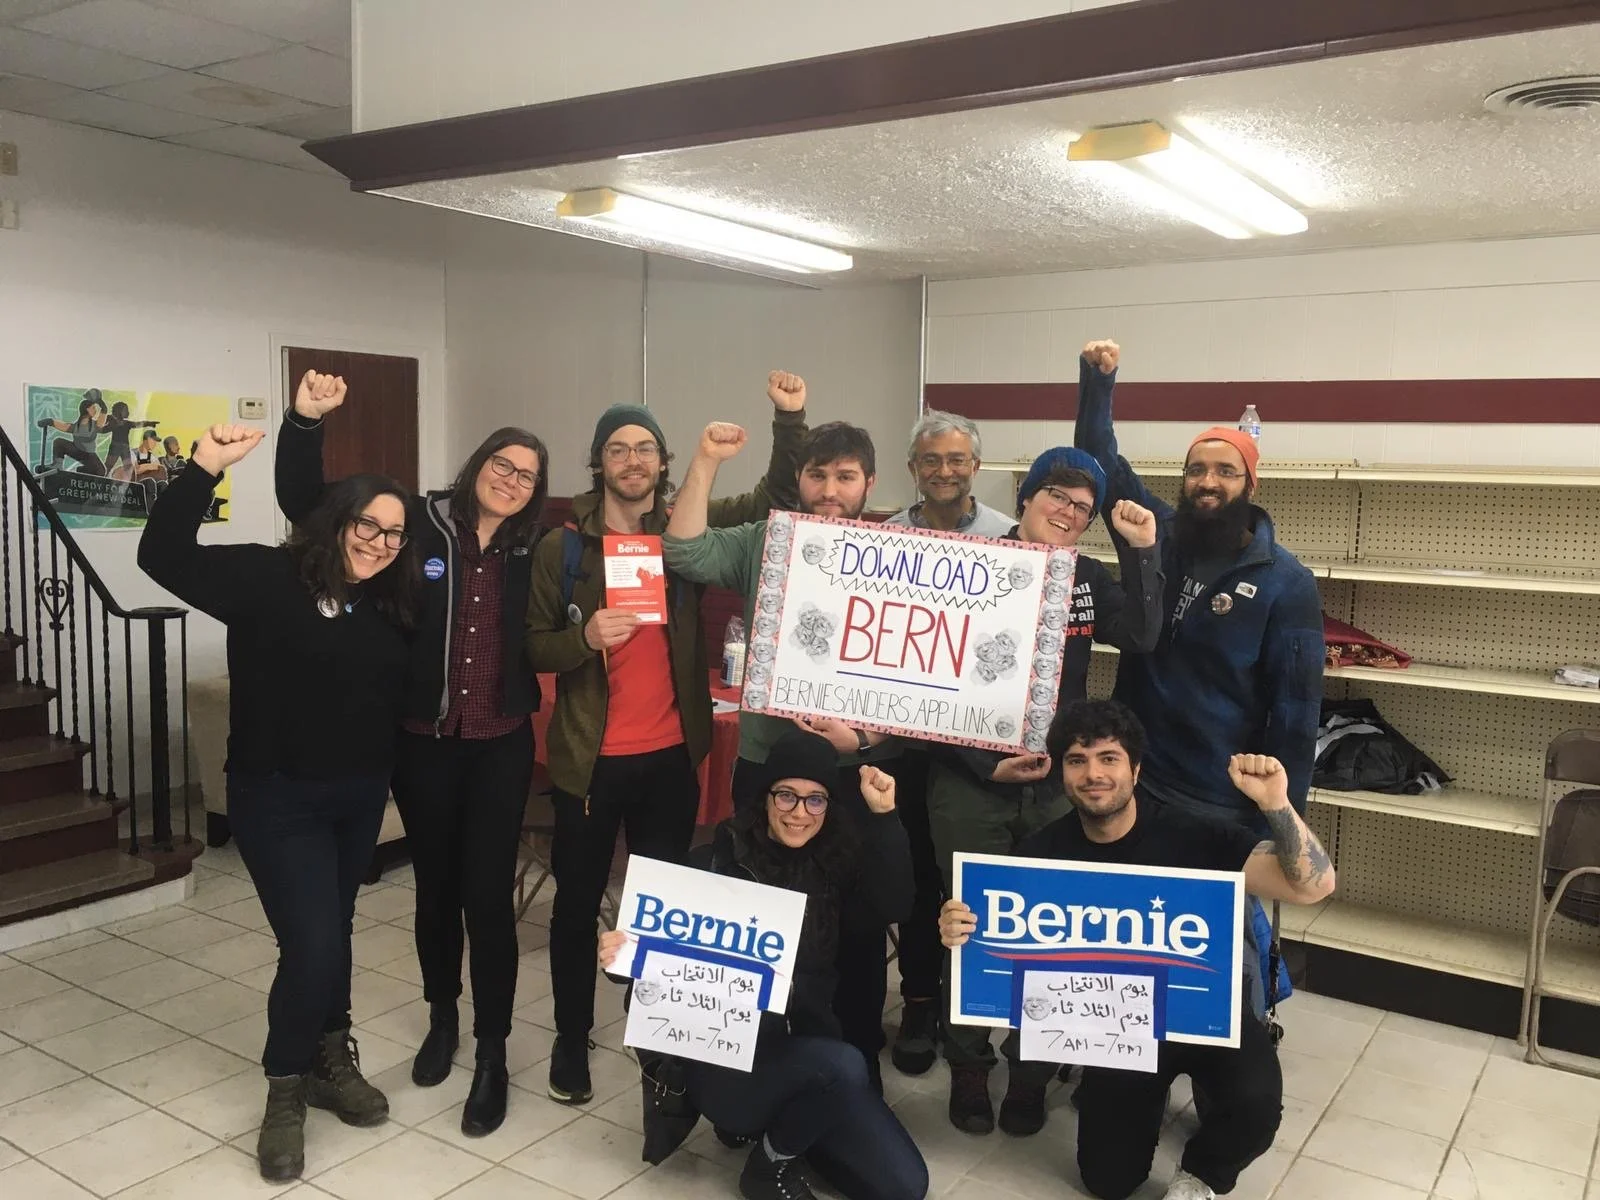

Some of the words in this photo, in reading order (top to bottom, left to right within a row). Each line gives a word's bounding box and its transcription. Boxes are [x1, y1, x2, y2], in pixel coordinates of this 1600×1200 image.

[59, 487, 92, 500] GREEN
[96, 493, 118, 503] NEW
[120, 496, 142, 506] DEAL
[70, 479, 102, 491] READY
[105, 484, 126, 494] FOR
[127, 487, 133, 496] A
[617, 543, 650, 553] Bernie
[840, 543, 989, 596] DOWNLOAD
[1072, 582, 1092, 595] all
[1075, 595, 1094, 607] all
[1078, 609, 1095, 621] all
[839, 595, 970, 678] BERN
[630, 892, 785, 963] Bernie
[982, 888, 1210, 957] Bernie
[728, 977, 755, 998] يوم
[1120, 983, 1148, 1003] يوم
[724, 1008, 751, 1028] يوم
[1120, 1013, 1149, 1032] يوم
